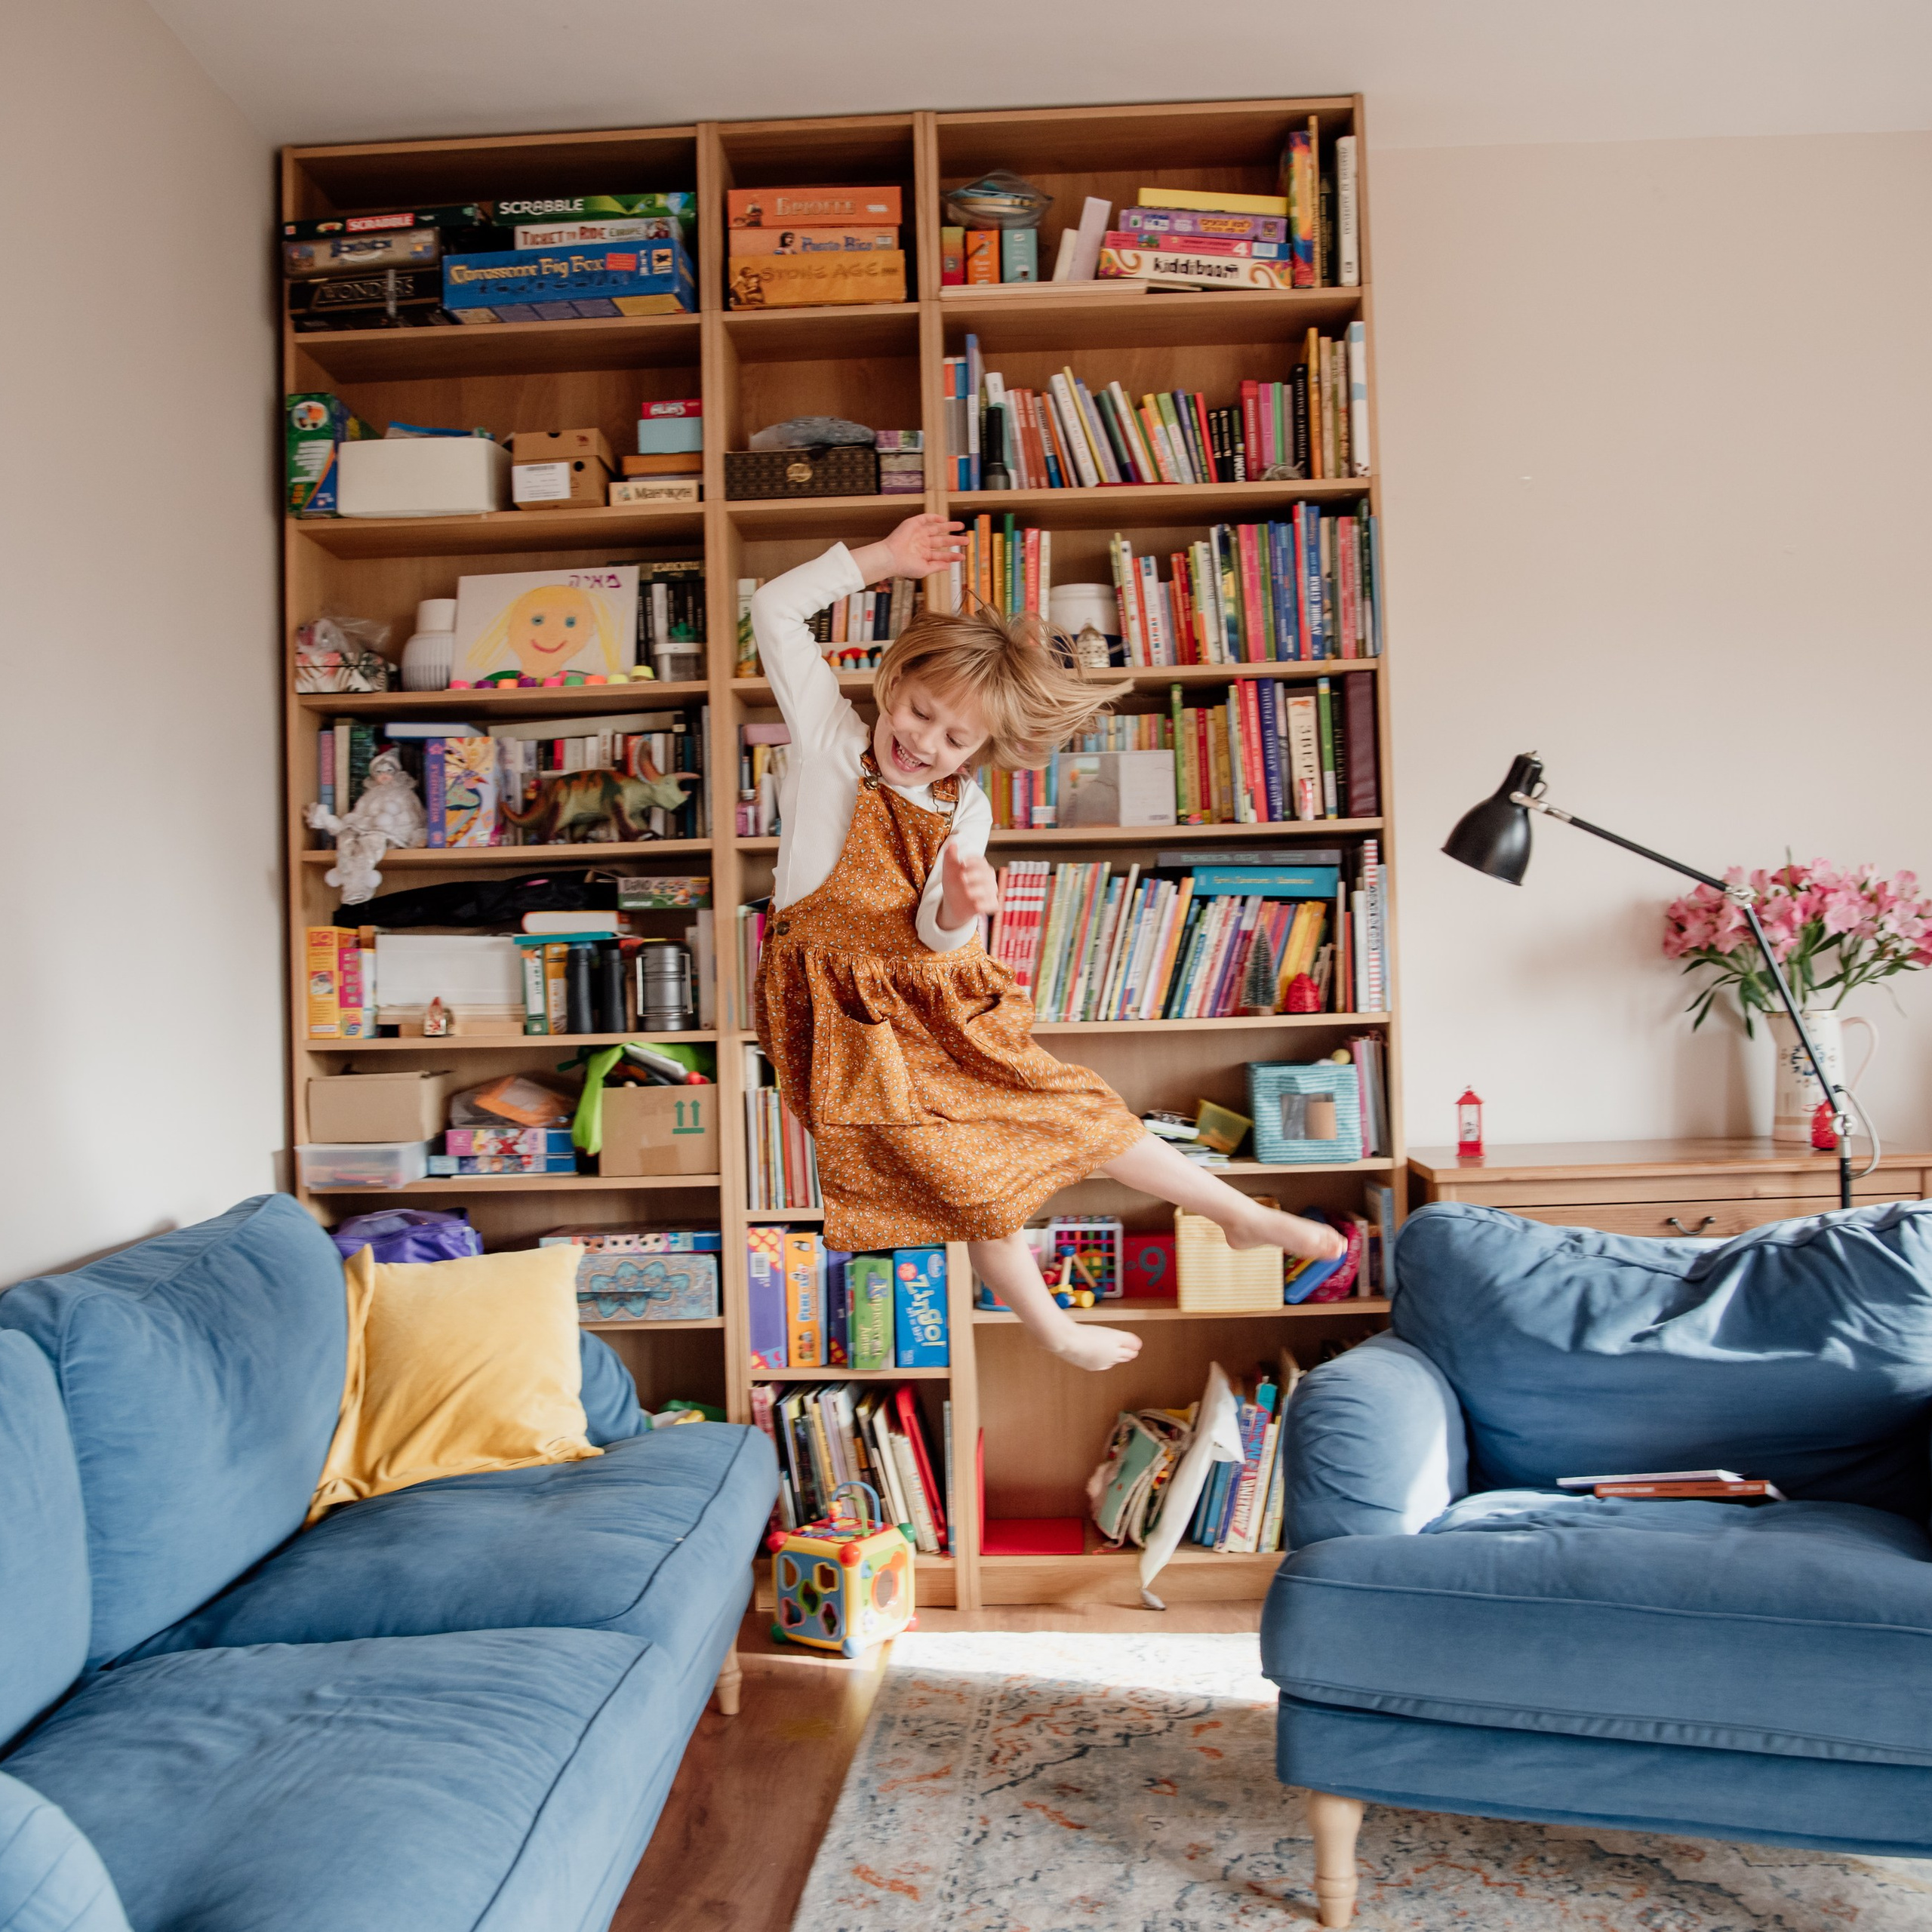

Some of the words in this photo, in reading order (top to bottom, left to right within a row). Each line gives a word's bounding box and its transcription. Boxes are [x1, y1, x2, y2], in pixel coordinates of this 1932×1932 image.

[499, 199, 584, 216] SCRABBLE
[349, 215, 414, 231] SCRABBLE
[521, 231, 564, 245] TICKET
[579, 226, 608, 241] RIDE
[1232, 242, 1249, 257] 4
[538, 257, 569, 278] Big
[568, 574, 623, 589] מאיה
[1138, 1245, 1168, 1286] 9
[904, 1273, 948, 1348] Zingo!
